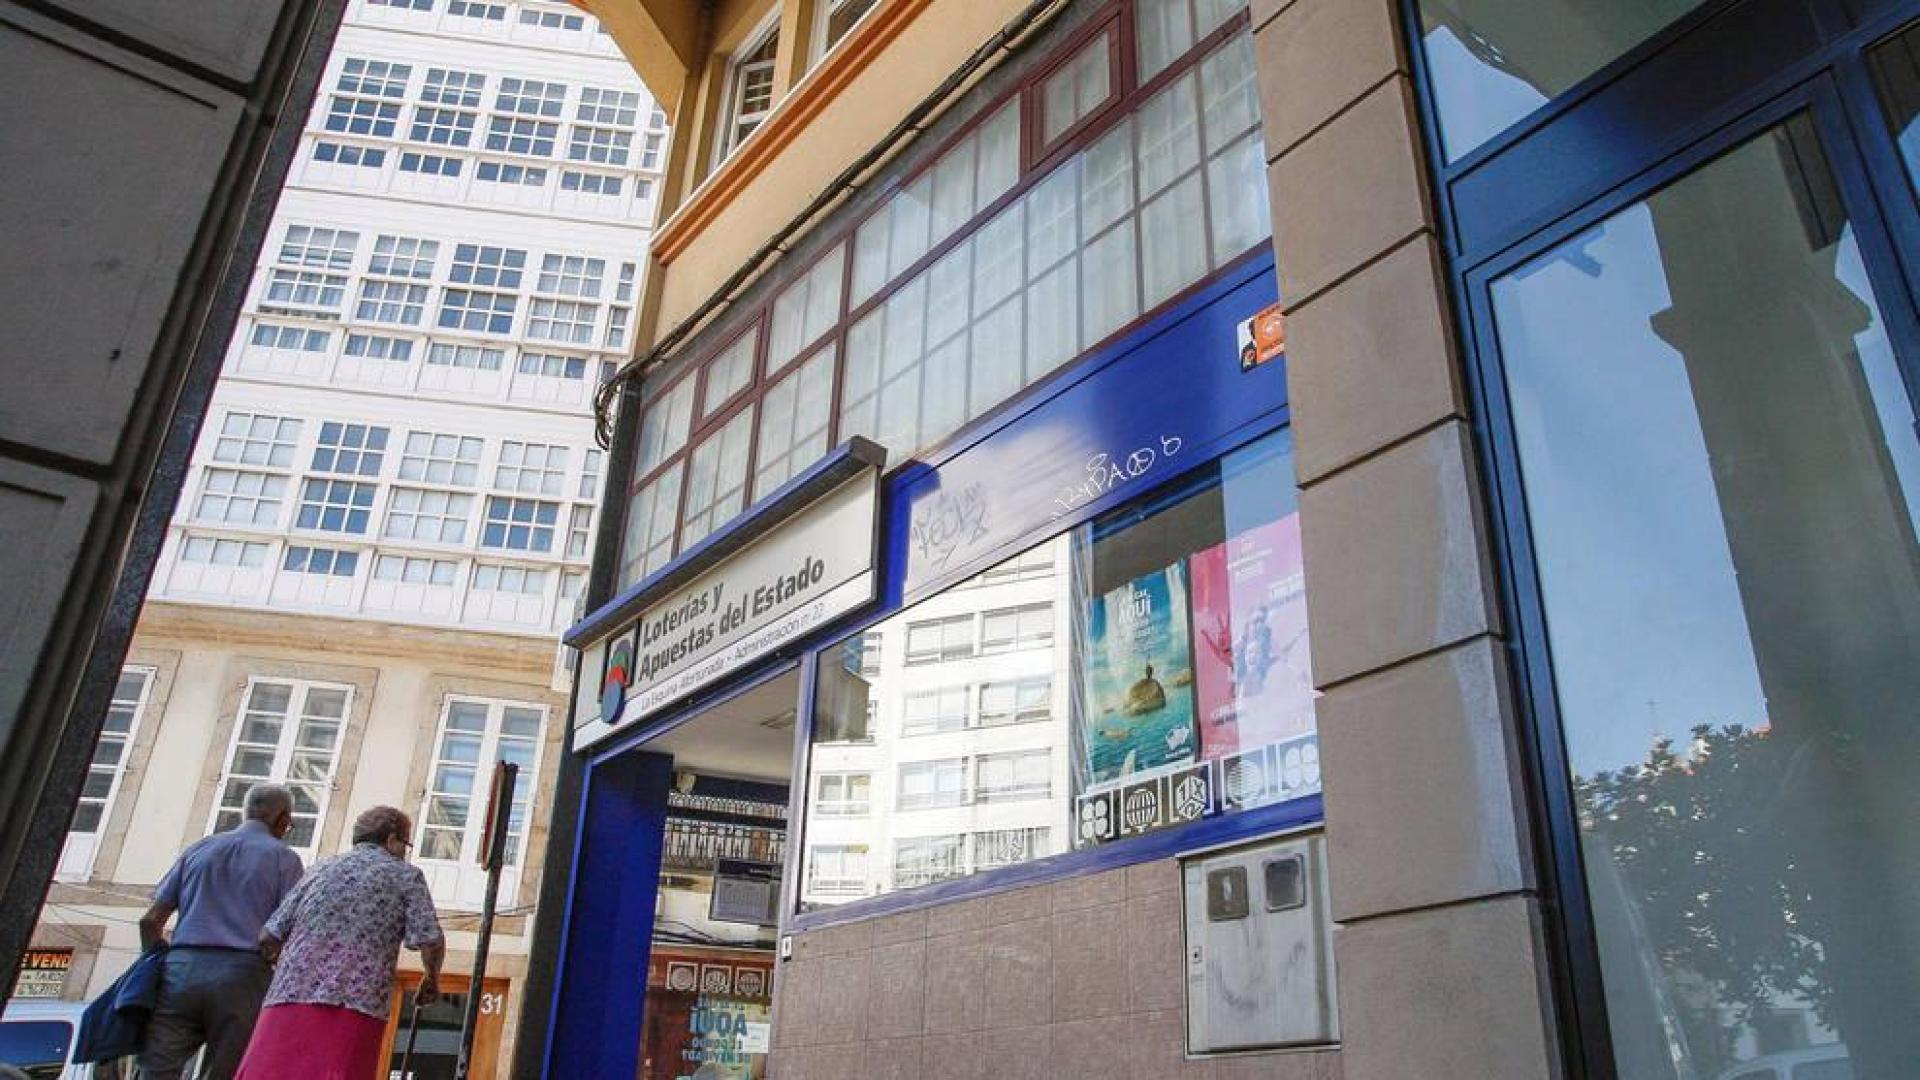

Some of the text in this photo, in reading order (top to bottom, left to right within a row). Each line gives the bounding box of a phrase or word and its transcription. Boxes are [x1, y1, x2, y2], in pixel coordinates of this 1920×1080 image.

[638, 556, 825, 681] Apuestas del Estado
[643, 581, 724, 648] Loterías y
[481, 993, 503, 1015] 31
